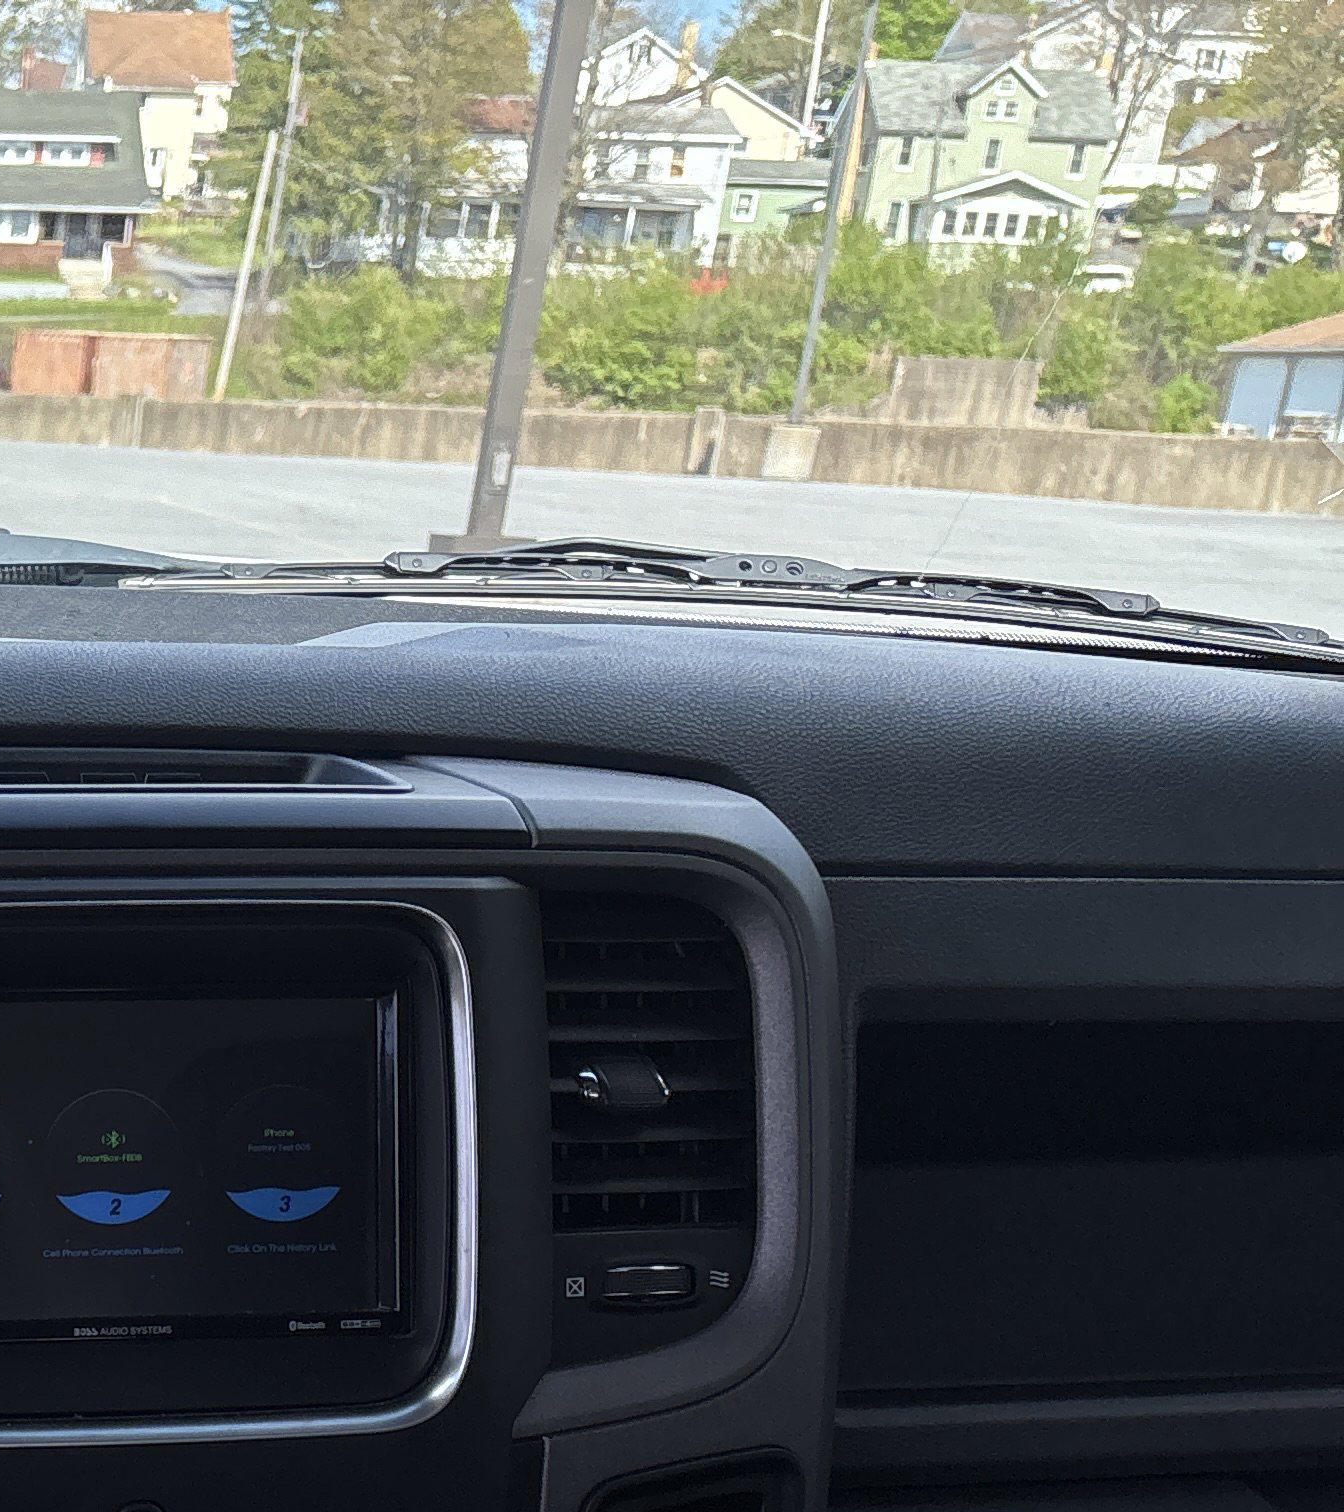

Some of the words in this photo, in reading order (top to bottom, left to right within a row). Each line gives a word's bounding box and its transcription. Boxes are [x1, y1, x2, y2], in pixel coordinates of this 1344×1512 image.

[109, 1198, 122, 1217] 2
[278, 1194, 291, 1213] 3
[62, 1248, 89, 1257] Phone
[91, 1247, 141, 1257] Connection
[252, 1244, 267, 1253] On
[73, 1327, 98, 1337] BOSS
[99, 1327, 129, 1336] AUDIO
[130, 1325, 173, 1336] SYSTEMS
